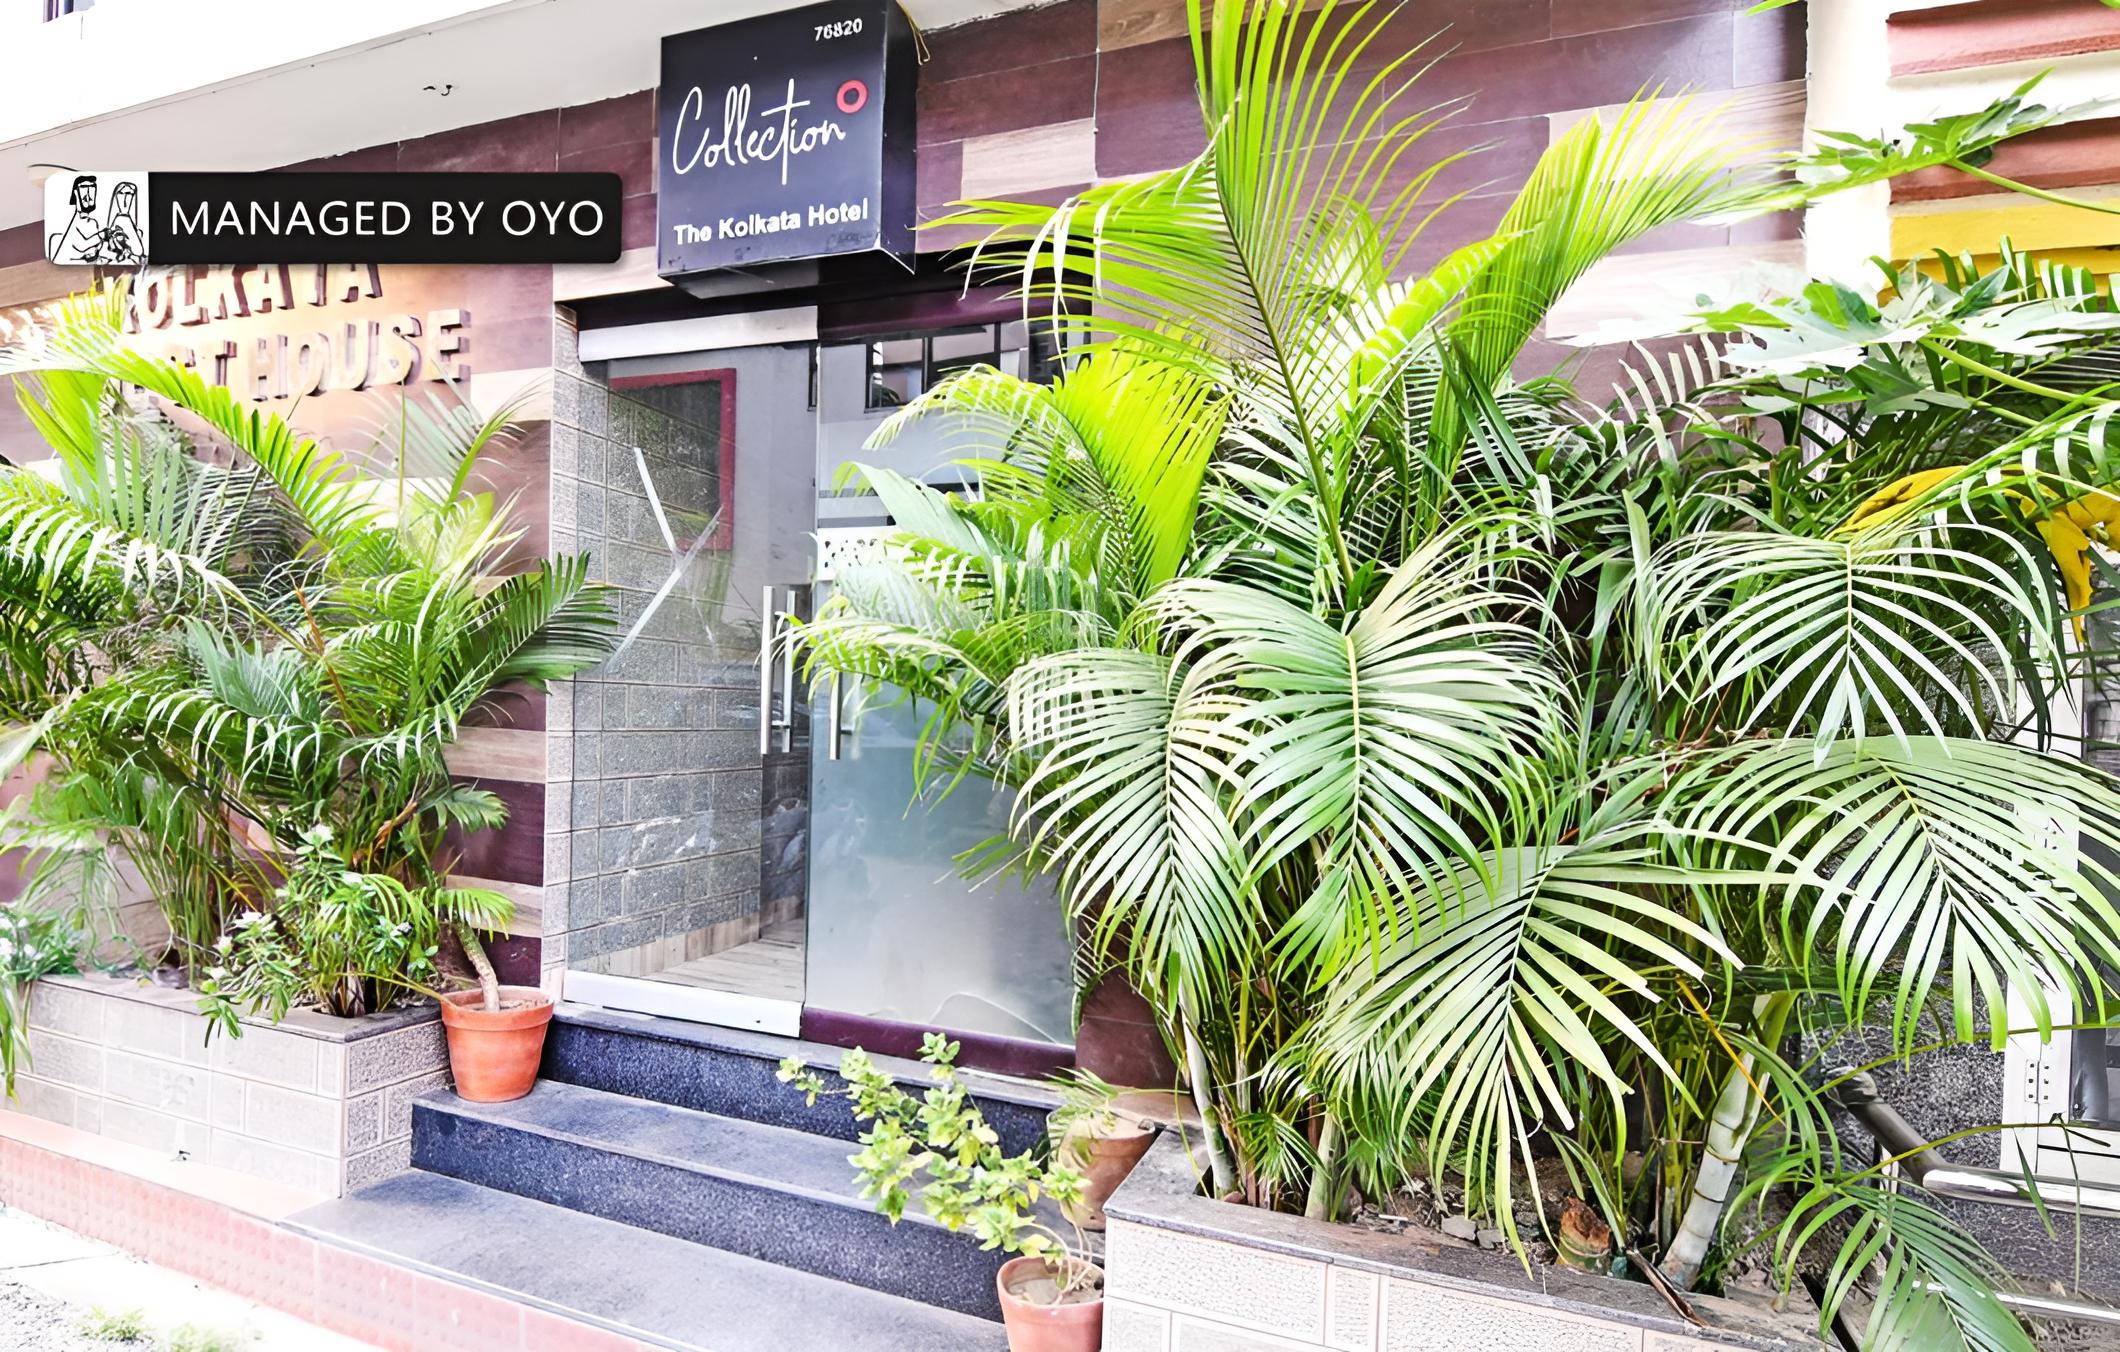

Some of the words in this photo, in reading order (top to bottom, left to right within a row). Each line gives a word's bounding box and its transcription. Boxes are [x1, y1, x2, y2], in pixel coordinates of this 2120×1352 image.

[814, 18, 863, 41] 76820
[672, 78, 846, 186] Collection
[674, 224, 712, 245] The
[719, 211, 800, 239] Kolkata
[809, 198, 867, 226] Hotel
[254, 309, 471, 401] HOUSE
